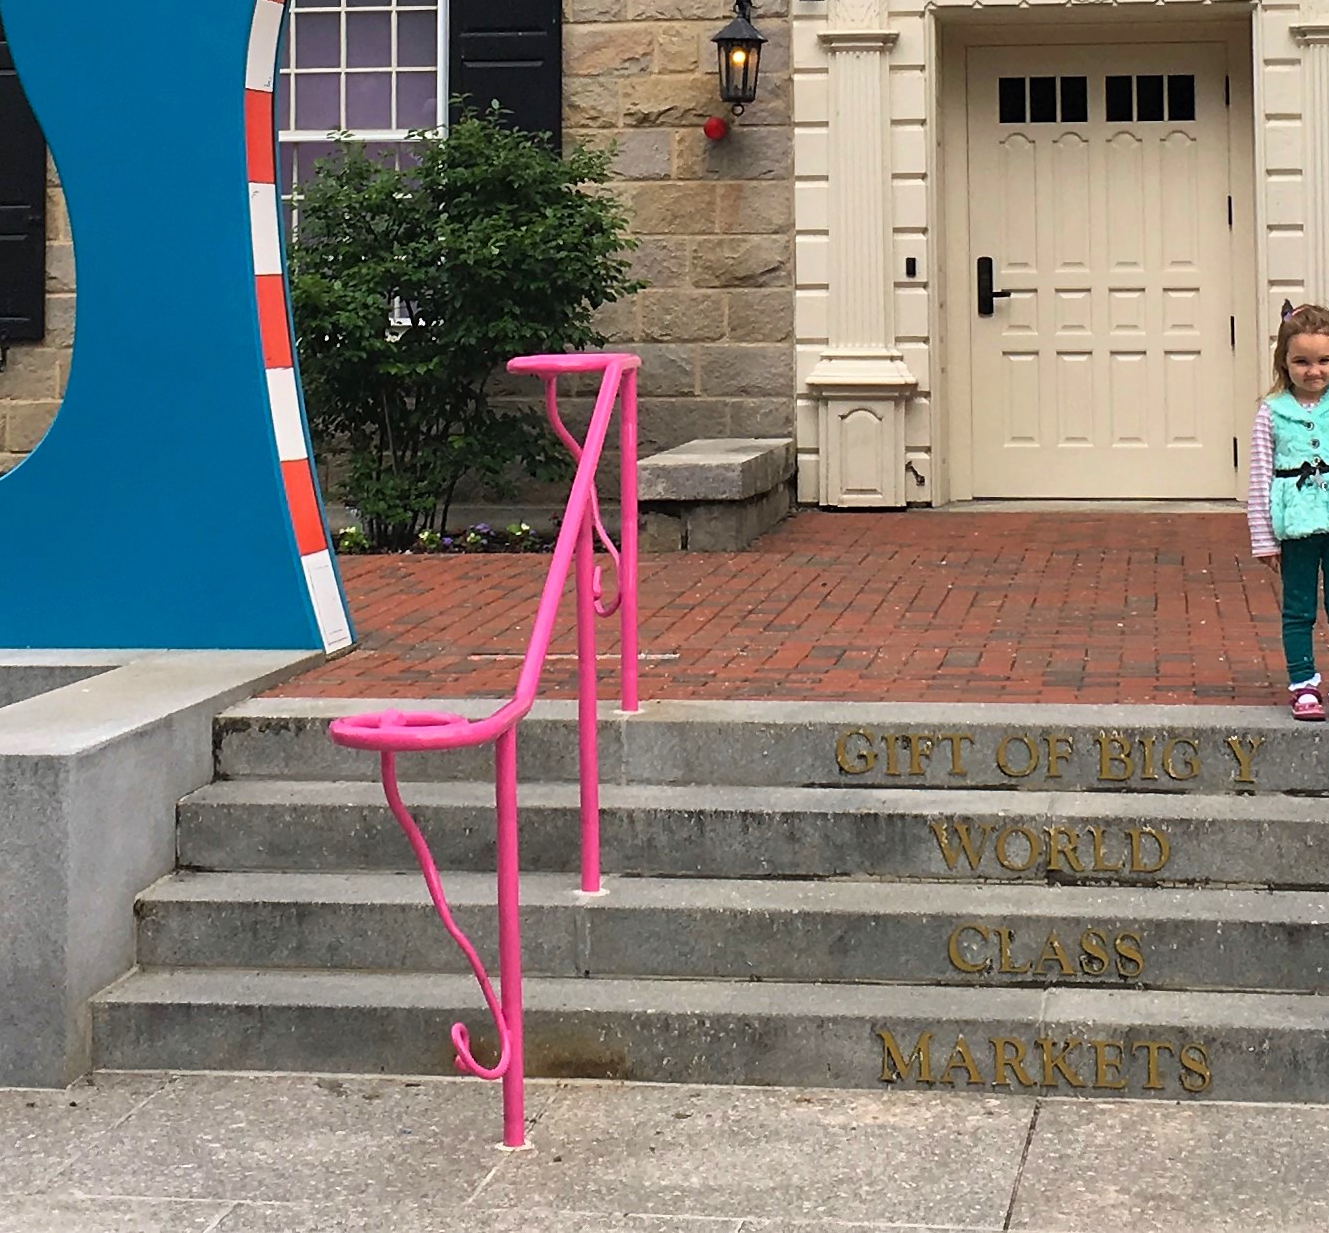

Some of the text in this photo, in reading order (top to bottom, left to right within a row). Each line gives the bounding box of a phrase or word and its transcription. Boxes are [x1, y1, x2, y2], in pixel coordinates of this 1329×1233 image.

[834, 729, 1264, 784] GIFT OF BIG Y
[931, 822, 1171, 874] WORLD
[948, 925, 1146, 978] CLASS
[876, 1030, 1213, 1093] MARKETS
